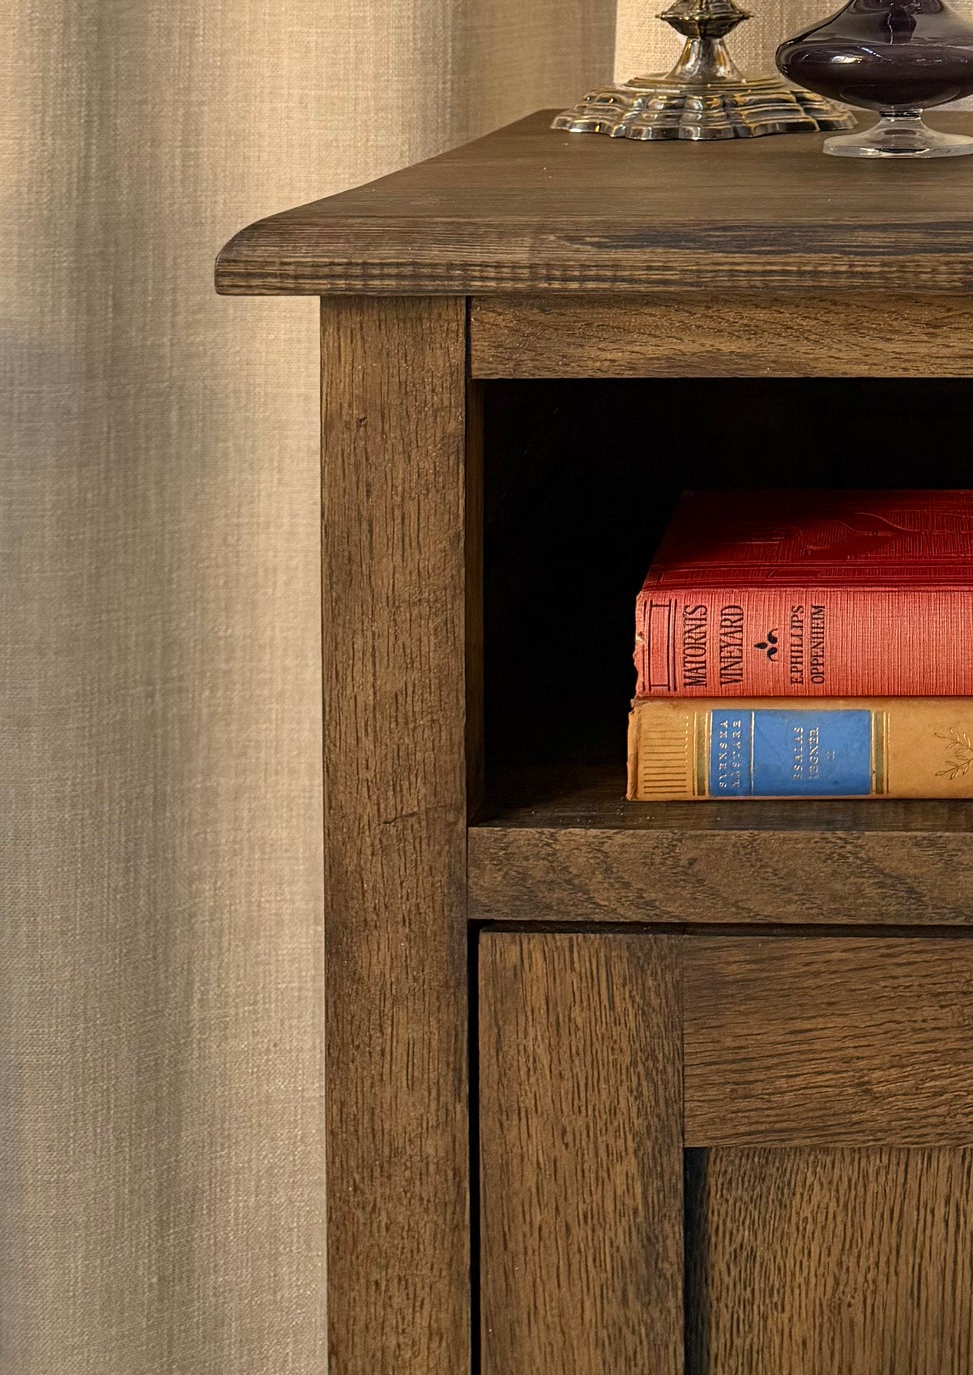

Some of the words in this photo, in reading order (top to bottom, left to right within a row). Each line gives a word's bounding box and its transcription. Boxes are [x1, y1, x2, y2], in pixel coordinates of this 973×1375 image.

[720, 605, 744, 687] VINEYARD
[810, 604, 825, 685] OPPENHEIM
[718, 720, 728, 788] SVENSKA
